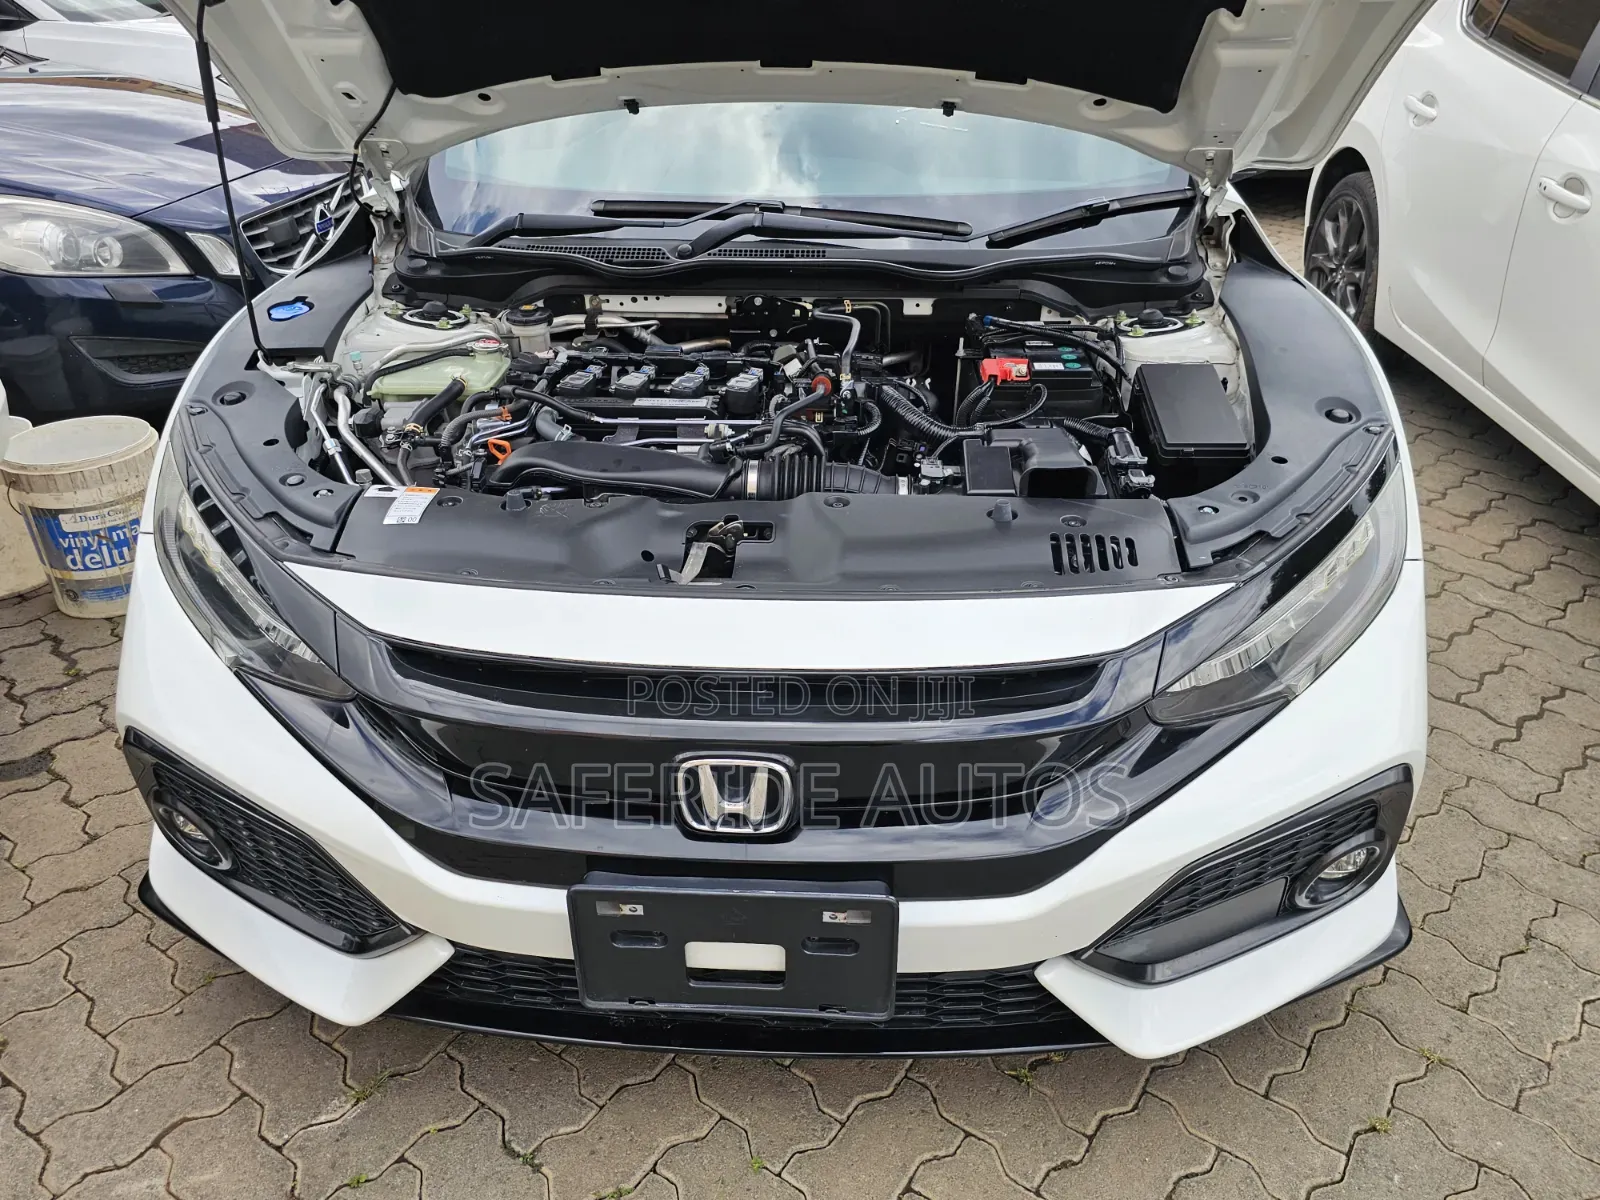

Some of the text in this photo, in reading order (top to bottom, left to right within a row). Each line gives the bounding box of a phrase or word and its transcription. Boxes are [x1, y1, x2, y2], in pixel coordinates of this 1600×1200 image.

[79, 508, 126, 523] DuraCo
[59, 524, 141, 550] vinyl ma
[66, 545, 132, 570] delu
